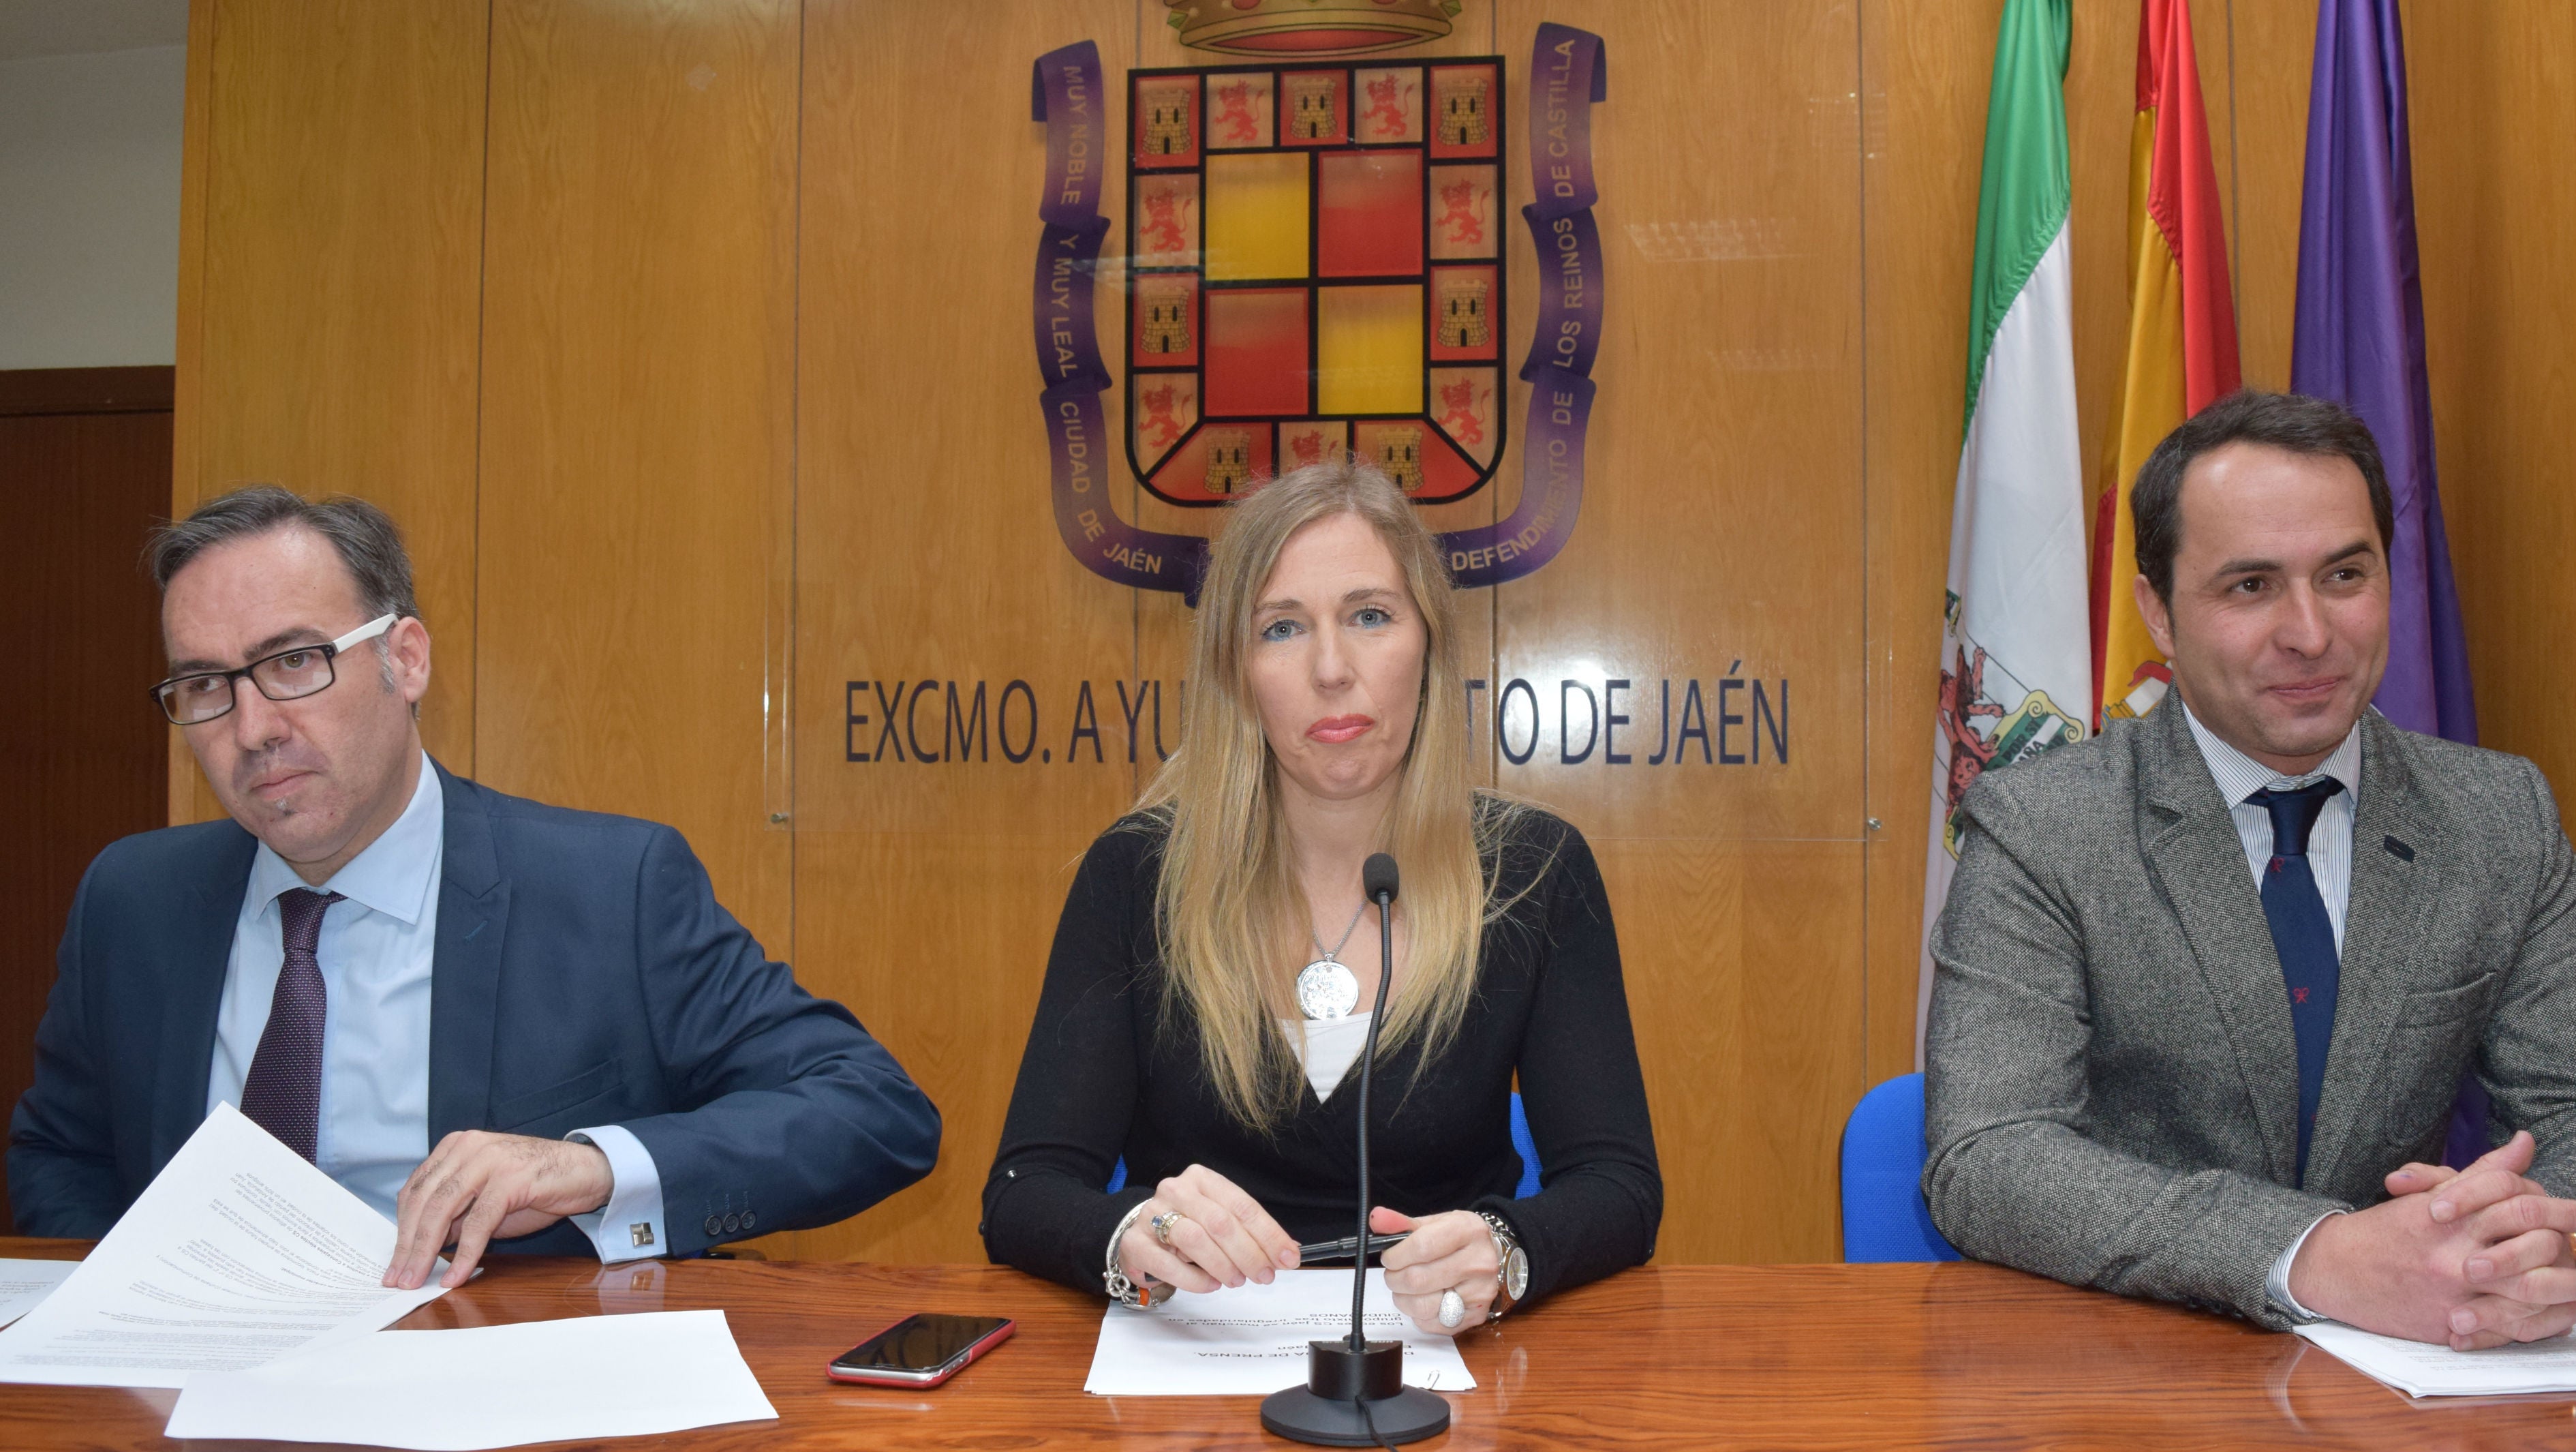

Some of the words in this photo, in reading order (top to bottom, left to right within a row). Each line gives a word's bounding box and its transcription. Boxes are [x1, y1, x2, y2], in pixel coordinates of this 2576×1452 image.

[1063, 65, 1088, 120] MUY
[1548, 39, 1576, 158] CASTILLA
[1060, 124, 1088, 205] NOBLE
[1551, 165, 1575, 198] DE
[1059, 234, 1079, 249] Y
[1553, 217, 1583, 309] REINOS
[1052, 258, 1073, 309] MUY
[1052, 316, 1078, 378] LEAL
[1552, 320, 1582, 367] LOS
[1060, 402, 1090, 494] CIUDAD
[1077, 509, 1105, 542] DE
[1103, 543, 1162, 574] JAÉN
[1452, 439, 1568, 571] DEFENDIMIENTO
[1551, 391, 1573, 425] DE
[846, 680, 1051, 764] EXCMO.
[1561, 679, 1632, 765] DE
[1649, 660, 1788, 765] JAÉN
